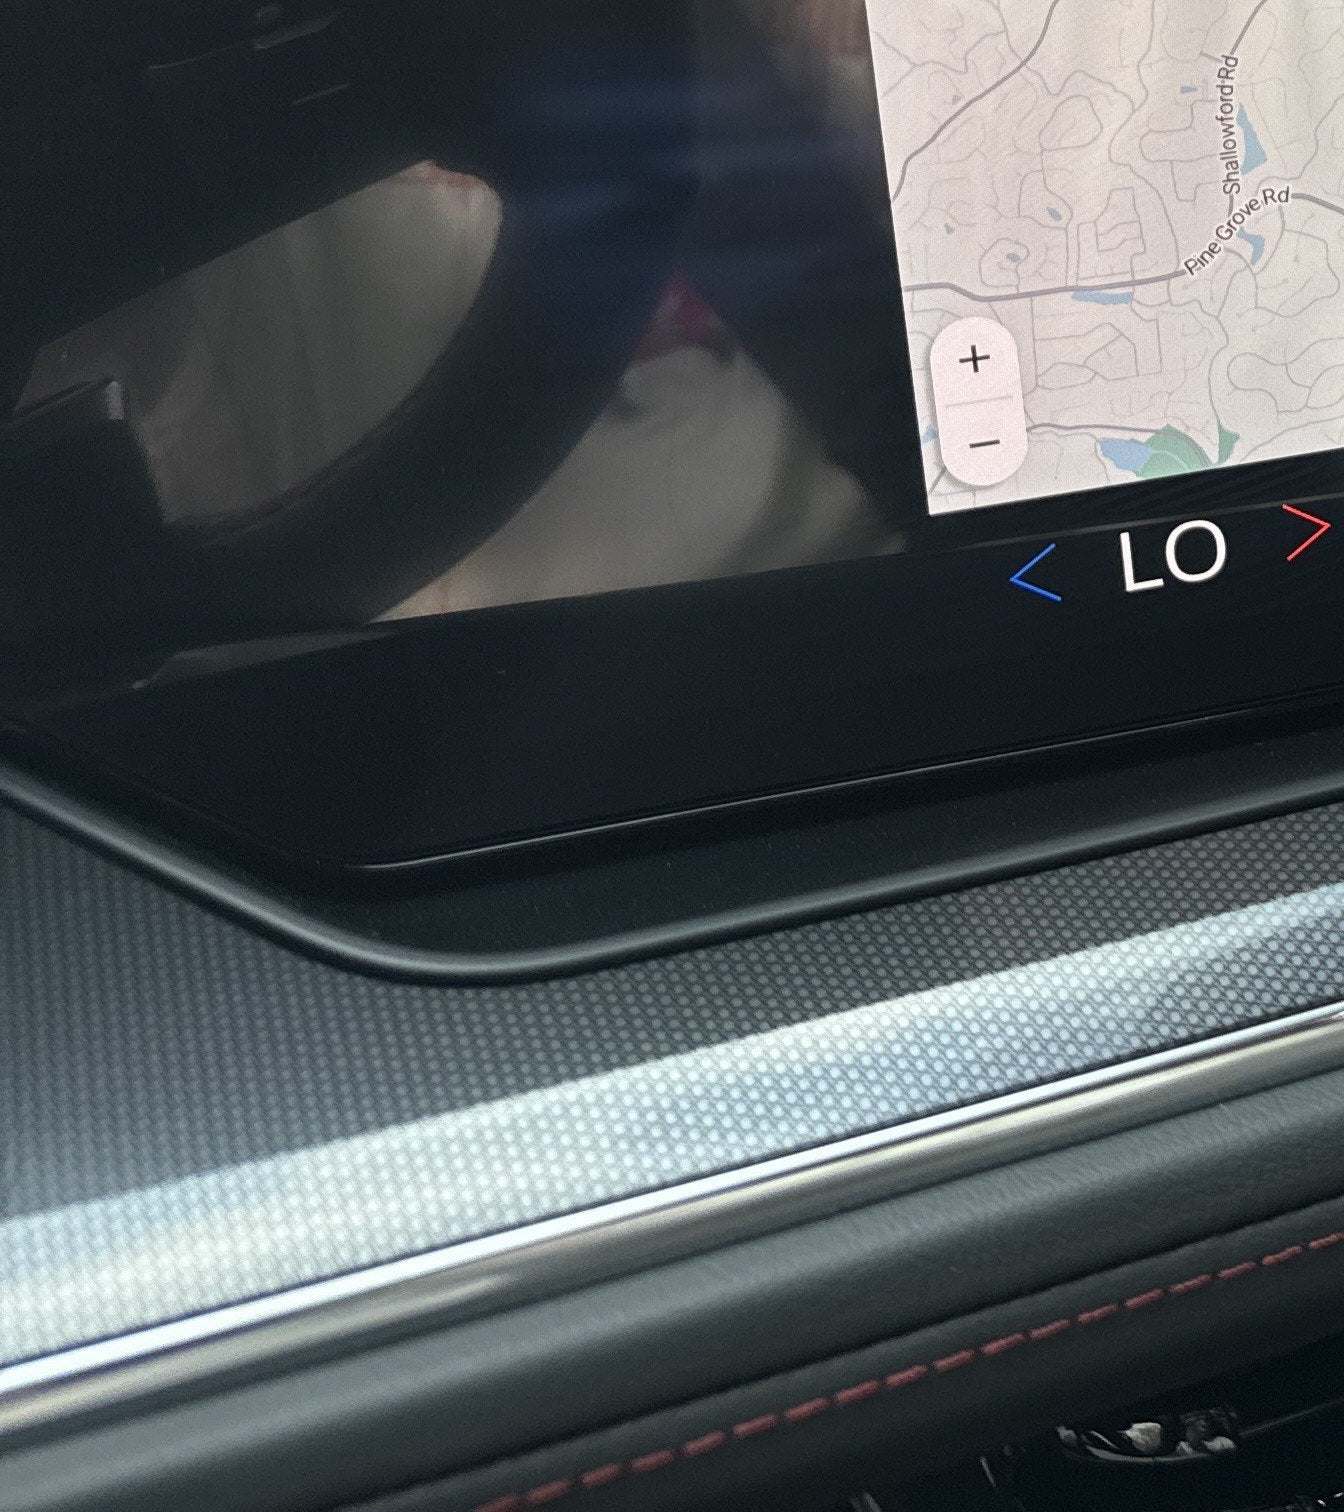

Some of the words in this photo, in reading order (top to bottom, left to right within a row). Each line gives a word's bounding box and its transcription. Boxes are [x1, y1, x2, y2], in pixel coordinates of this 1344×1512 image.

[1217, 55, 1239, 81] Rd
[1216, 85, 1240, 195] Shallowford
[1183, 242, 1220, 276] Pine
[1215, 196, 1262, 240] Grove
[1261, 186, 1290, 206] Rd
[1120, 518, 1227, 593] LO
